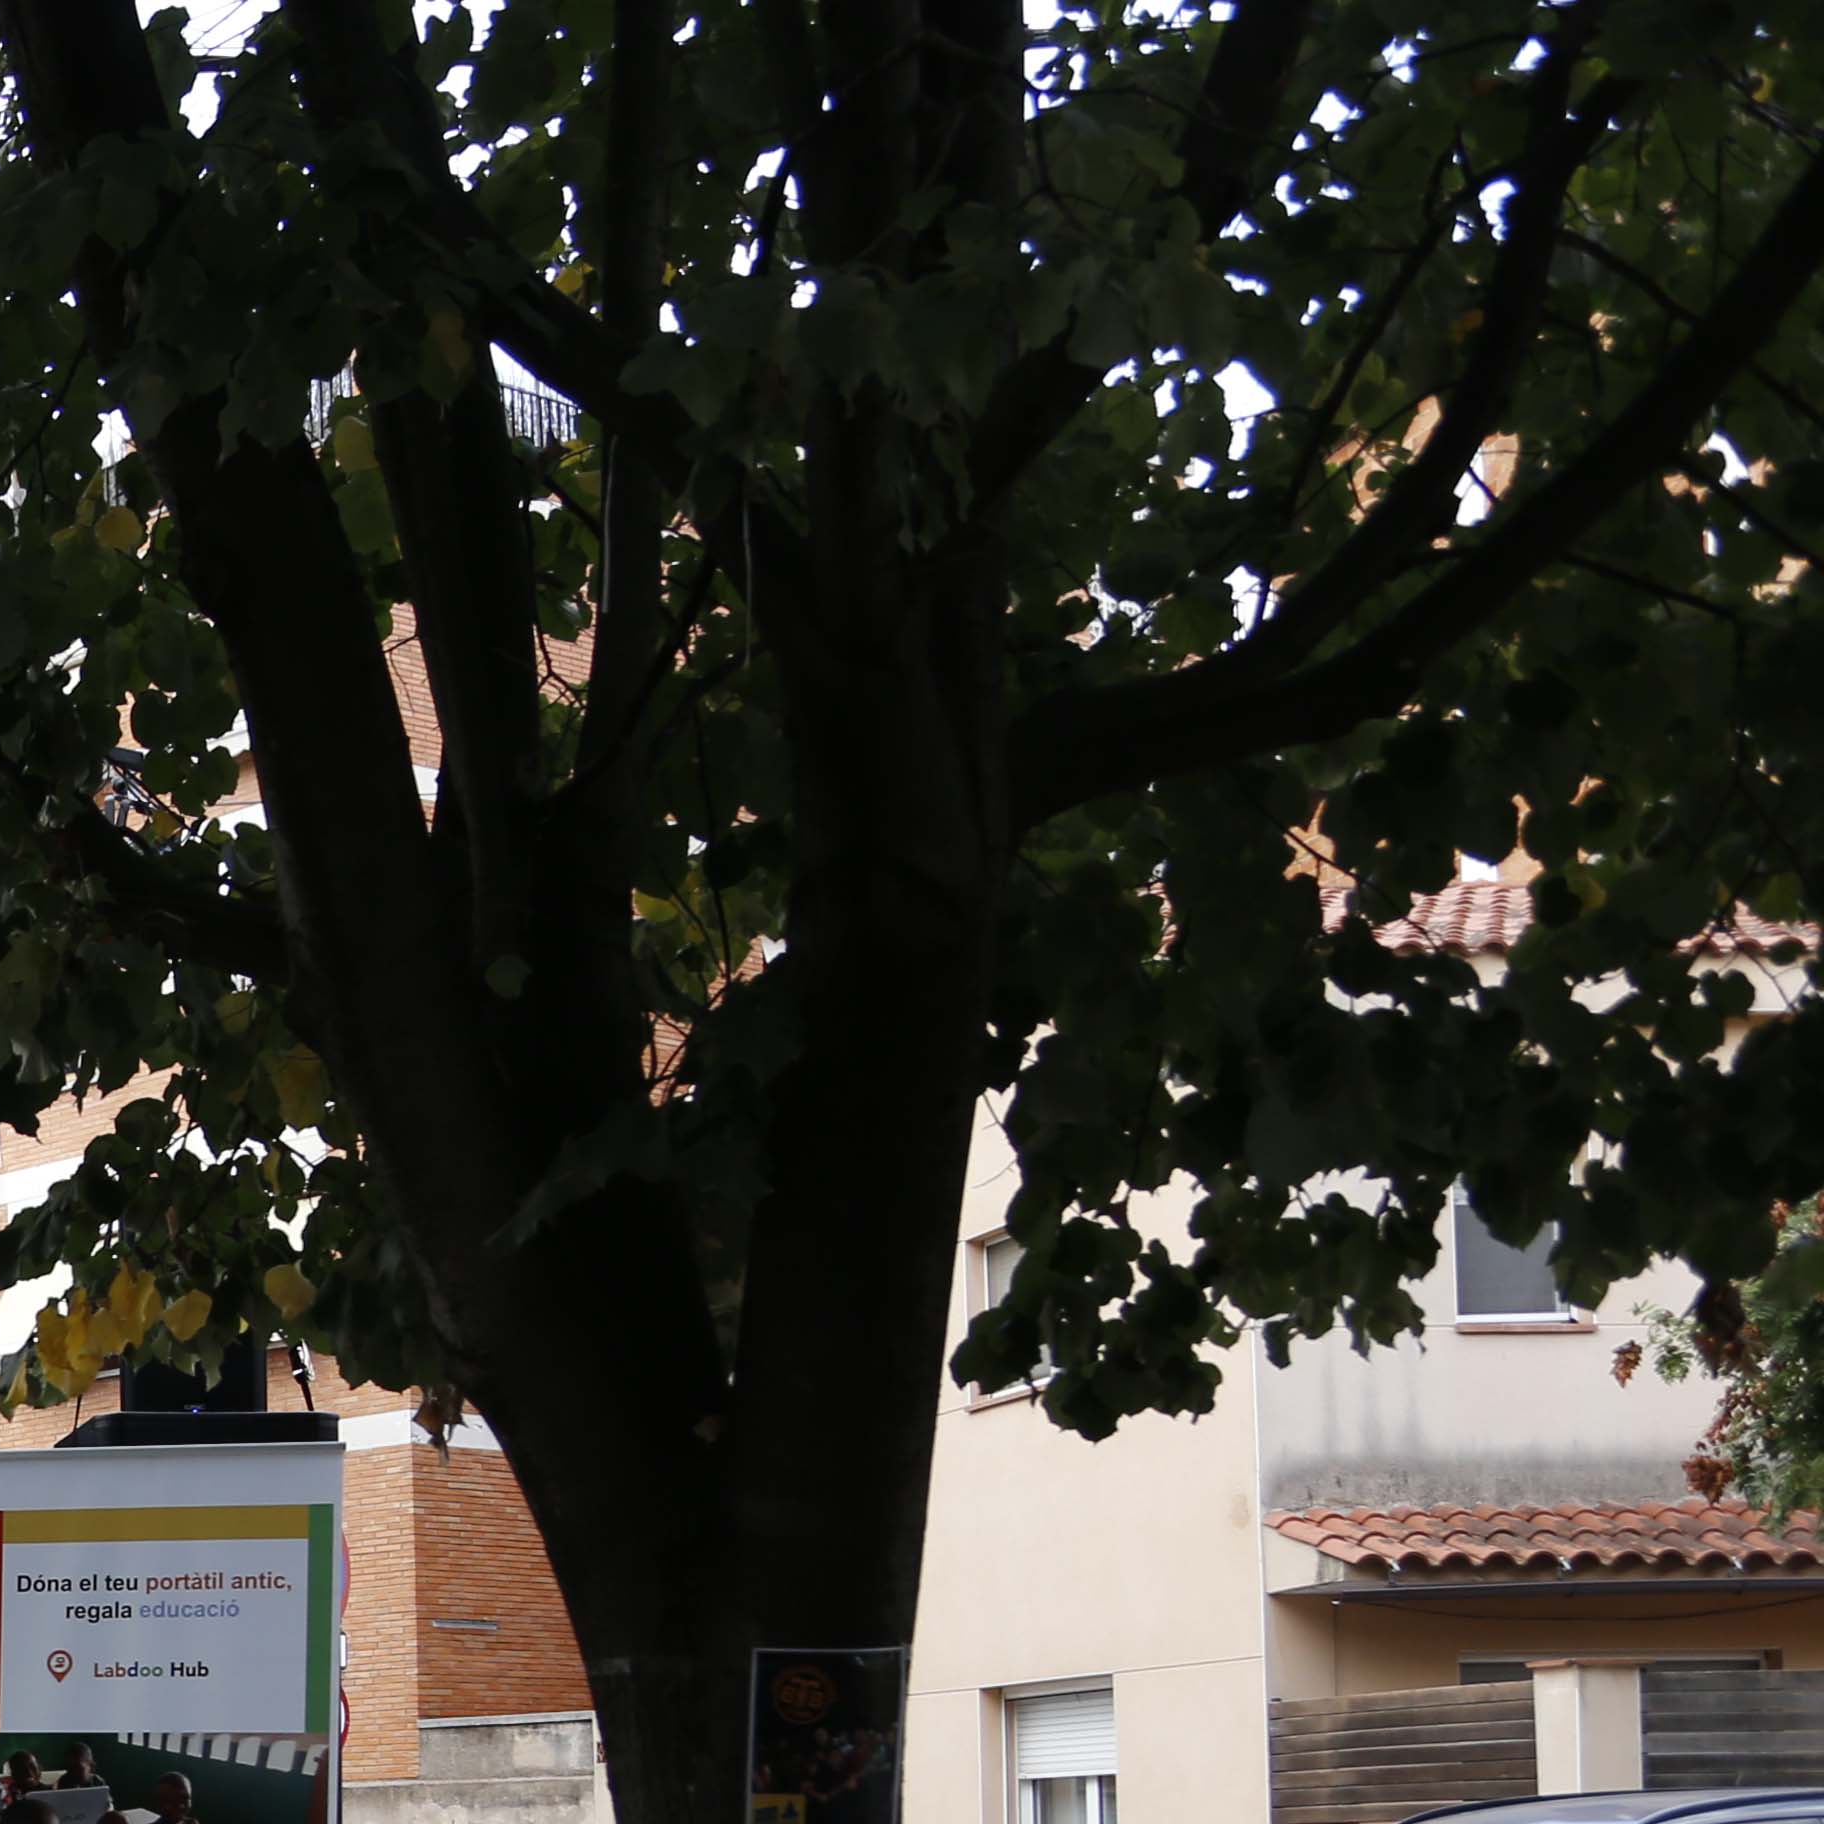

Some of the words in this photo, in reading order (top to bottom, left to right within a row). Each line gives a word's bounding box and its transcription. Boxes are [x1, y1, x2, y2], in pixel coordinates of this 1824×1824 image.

[17, 1575, 72, 1593] Dóna
[79, 1574, 97, 1592] el
[105, 1576, 138, 1592] teu
[145, 1572, 224, 1595] portàtil
[231, 1571, 293, 1592] antic,
[65, 1601, 132, 1623] regala
[139, 1600, 240, 1618] educació
[94, 1661, 164, 1678] Labdoo
[170, 1661, 209, 1678] Hub
